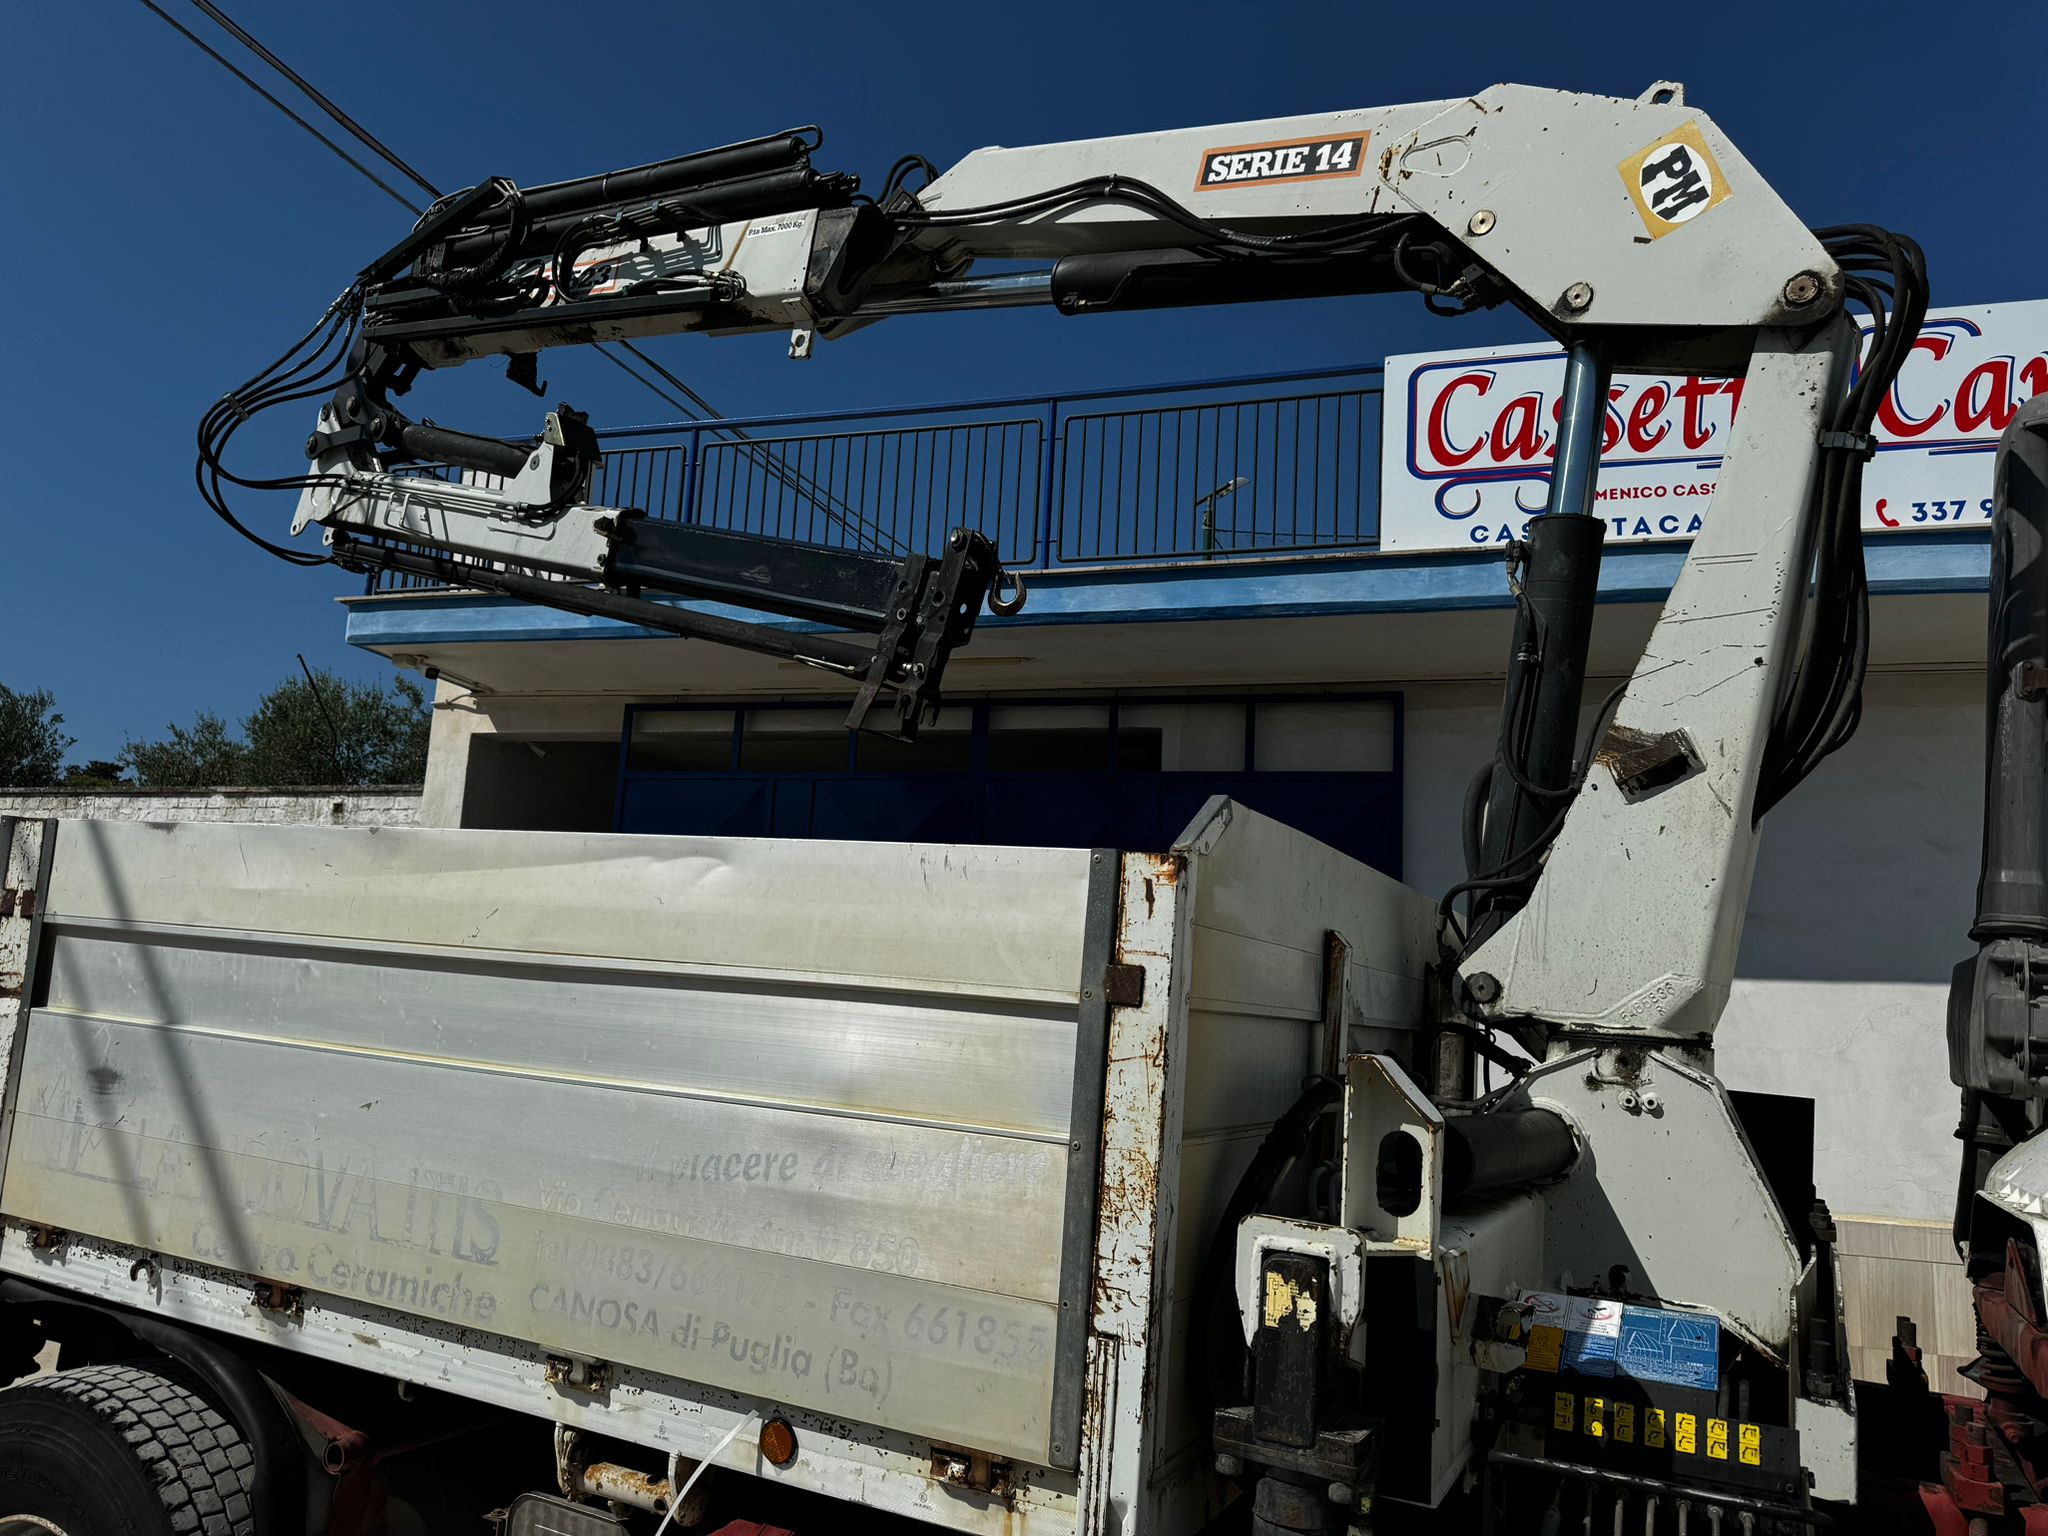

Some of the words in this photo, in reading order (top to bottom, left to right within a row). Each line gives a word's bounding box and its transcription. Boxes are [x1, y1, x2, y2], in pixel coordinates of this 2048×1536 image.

[1207, 145, 1308, 182] SERIE
[1315, 141, 1353, 172] 14
[1640, 143, 1711, 221] PM
[1594, 486, 1667, 501] MENICO
[1912, 499, 1967, 523] 337
[1979, 498, 1993, 519] 9
[664, 1149, 799, 1192] piacere
[307, 1243, 497, 1322] Ceramiche
[828, 1286, 893, 1333] Fax
[528, 1283, 660, 1338] CANOSA
[671, 1313, 701, 1350] di
[711, 1321, 814, 1378] Puglia
[823, 1345, 893, 1409] (Ba)
